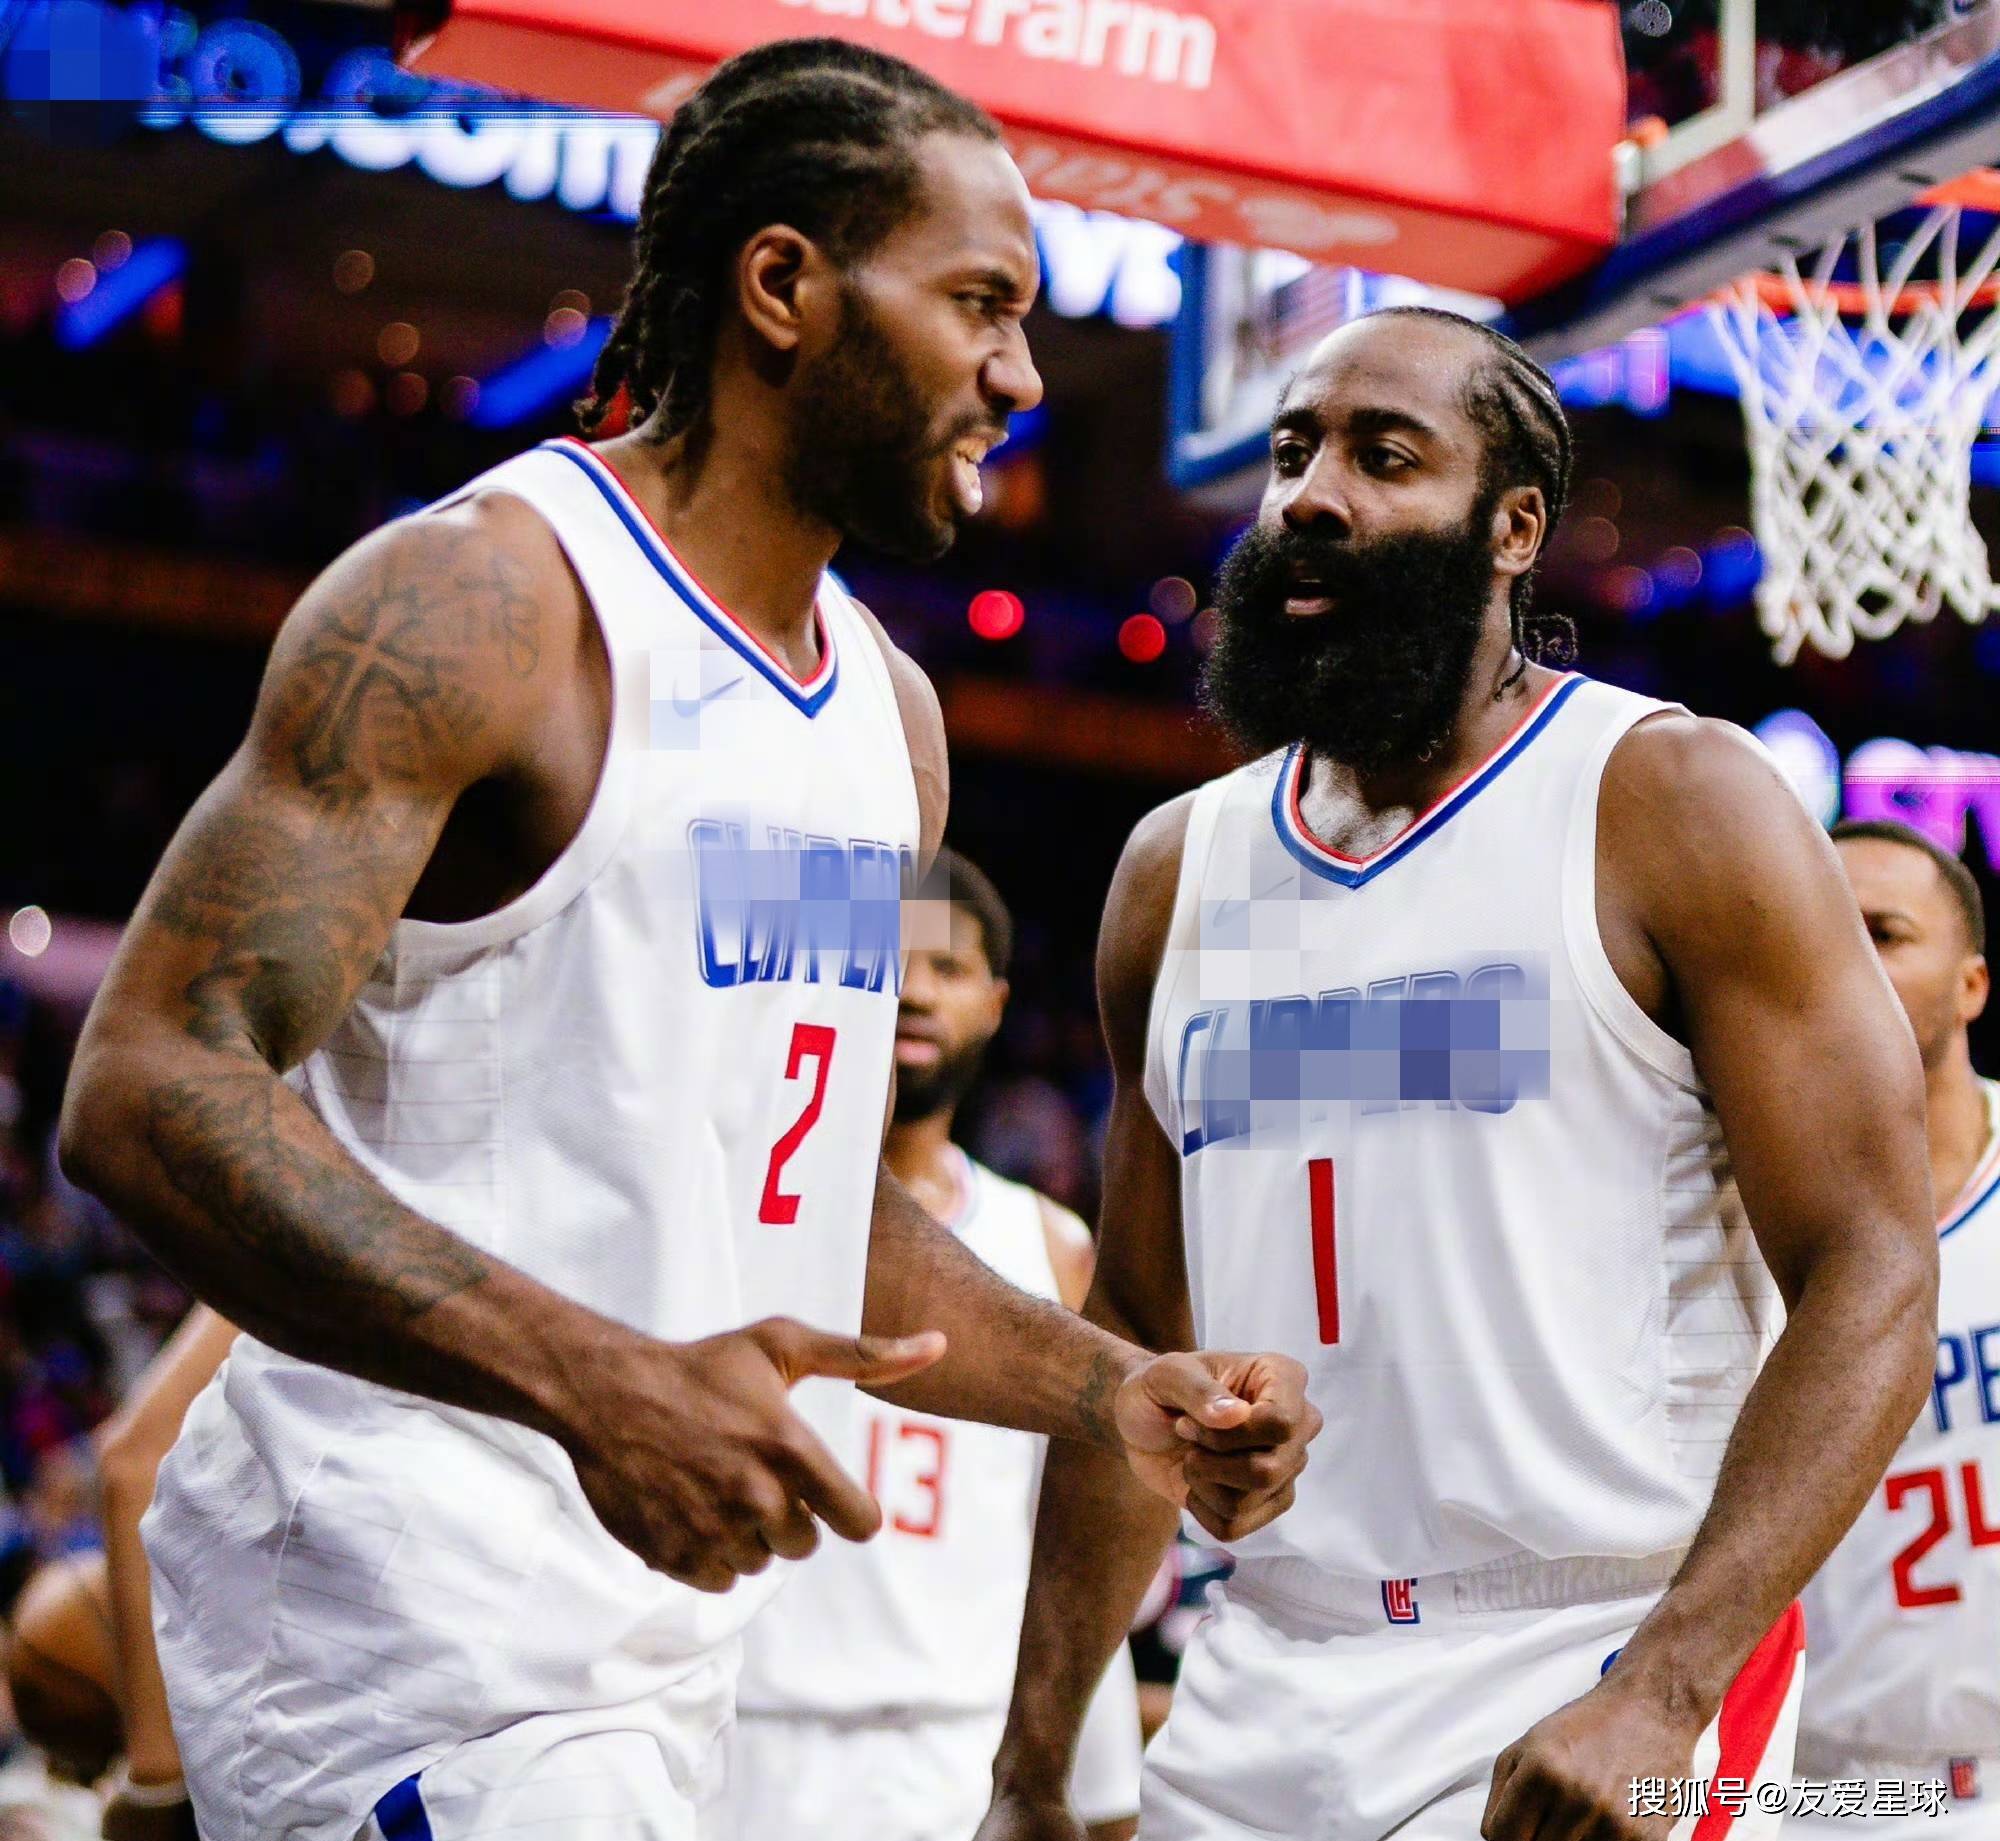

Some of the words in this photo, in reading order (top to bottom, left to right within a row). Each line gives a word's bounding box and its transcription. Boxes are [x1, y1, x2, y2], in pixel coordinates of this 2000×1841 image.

[758, 1022, 837, 1225] 2
[1308, 1157, 1340, 1345] 1
[866, 1415, 949, 1538] 13
